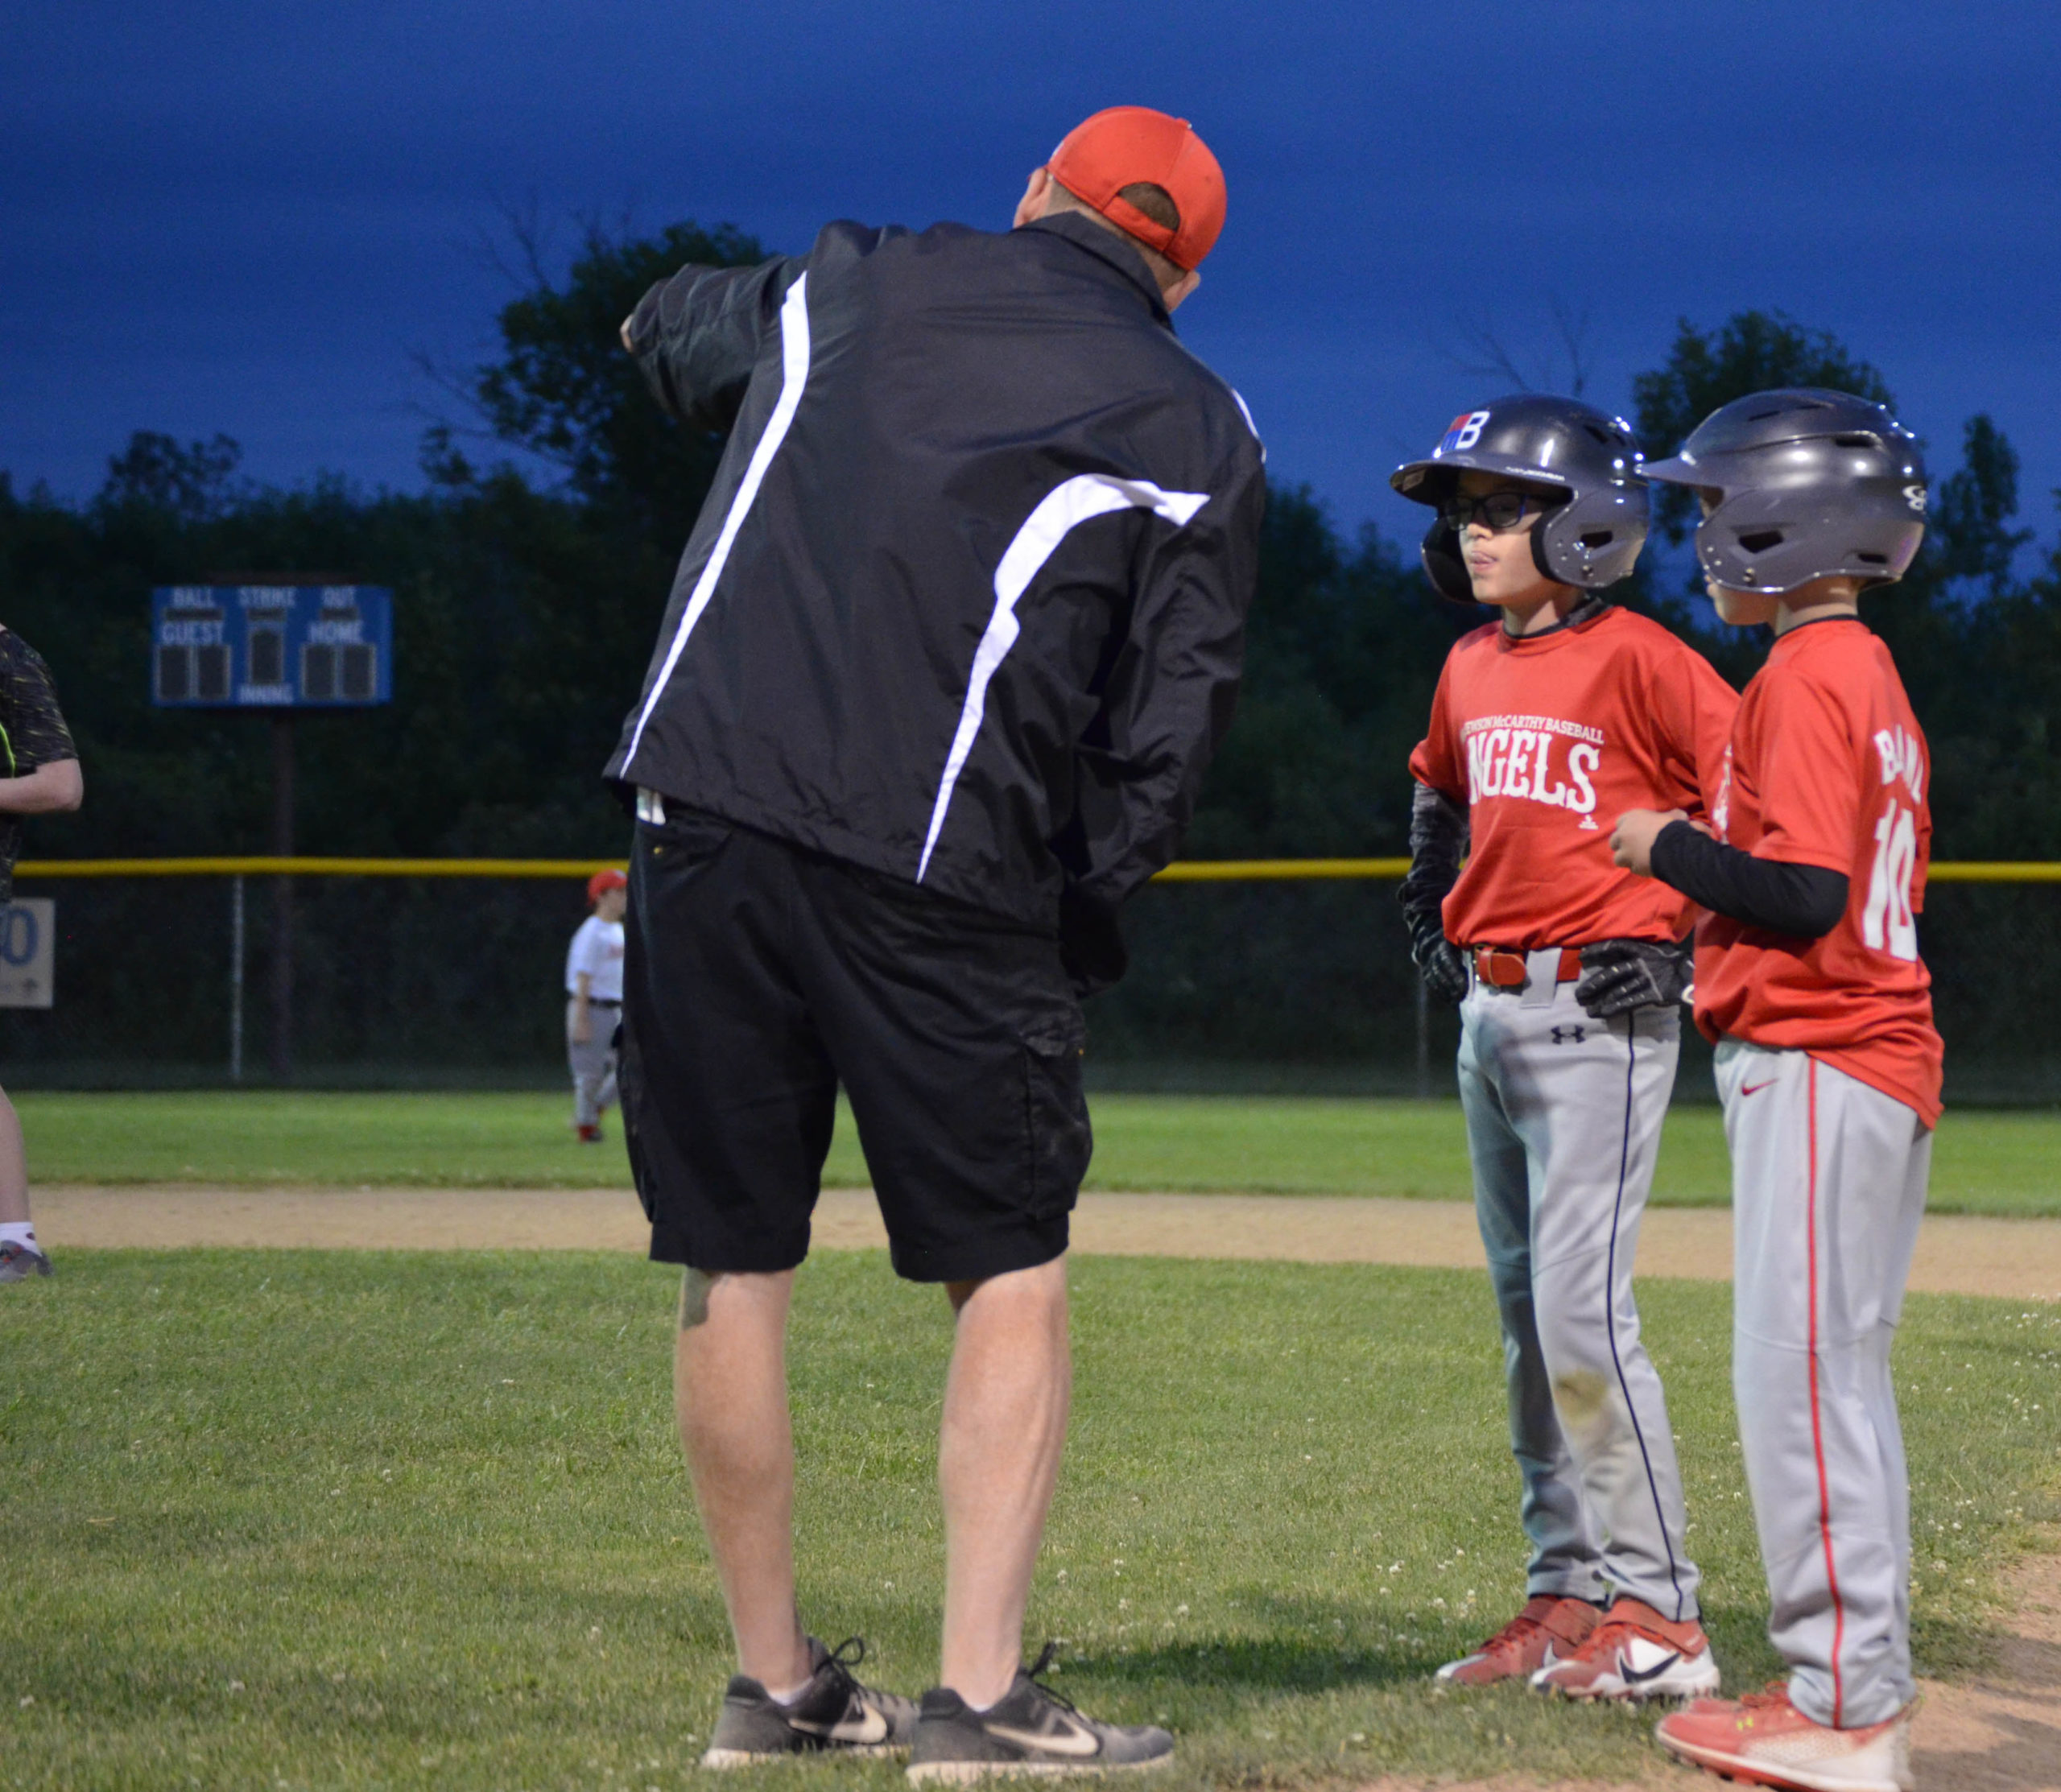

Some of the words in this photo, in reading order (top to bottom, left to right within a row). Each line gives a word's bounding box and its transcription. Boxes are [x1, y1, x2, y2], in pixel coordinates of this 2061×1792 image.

[172, 587, 214, 606] BALL
[238, 587, 296, 606] STRIKE
[323, 587, 356, 606] OUT
[162, 621, 222, 642] GUEST
[310, 621, 363, 642] HOME
[1495, 714, 1545, 731] McCARTHY
[1545, 717, 1605, 745] BASEBALL
[1467, 728, 1600, 814] NGELS
[1863, 798, 1918, 962] 10
